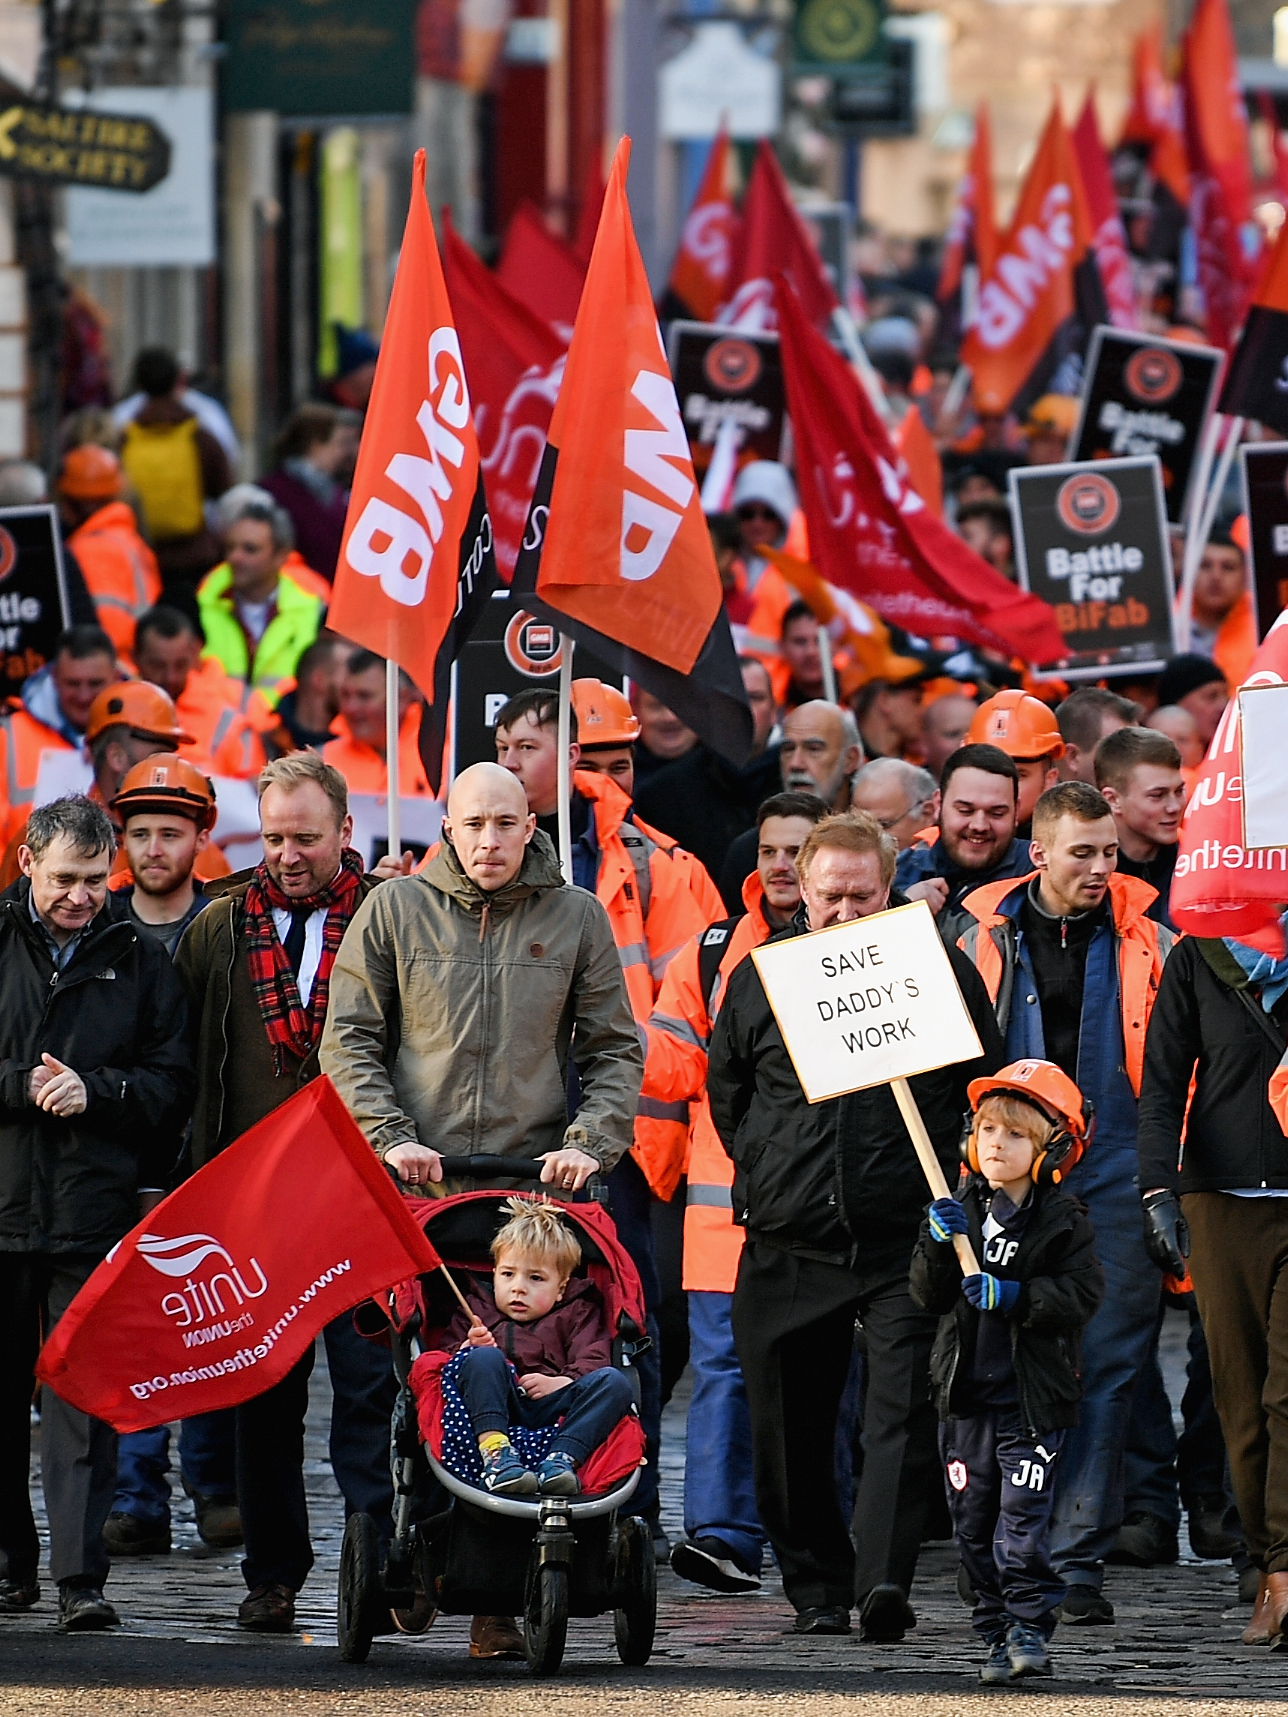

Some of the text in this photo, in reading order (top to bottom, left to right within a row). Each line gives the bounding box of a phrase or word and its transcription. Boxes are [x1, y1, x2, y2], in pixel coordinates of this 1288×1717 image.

[23, 111, 150, 148] SALTIRE
[19, 145, 147, 184] SOCIETY
[1100, 401, 1186, 444] Battle
[1046, 541, 1144, 580] Battle
[1070, 572, 1124, 604] For
[1056, 596, 1150, 634] BiFab
[821, 944, 884, 977] SAVE
[841, 1018, 916, 1054] WORK
[1011, 1459, 1044, 1491] JA
